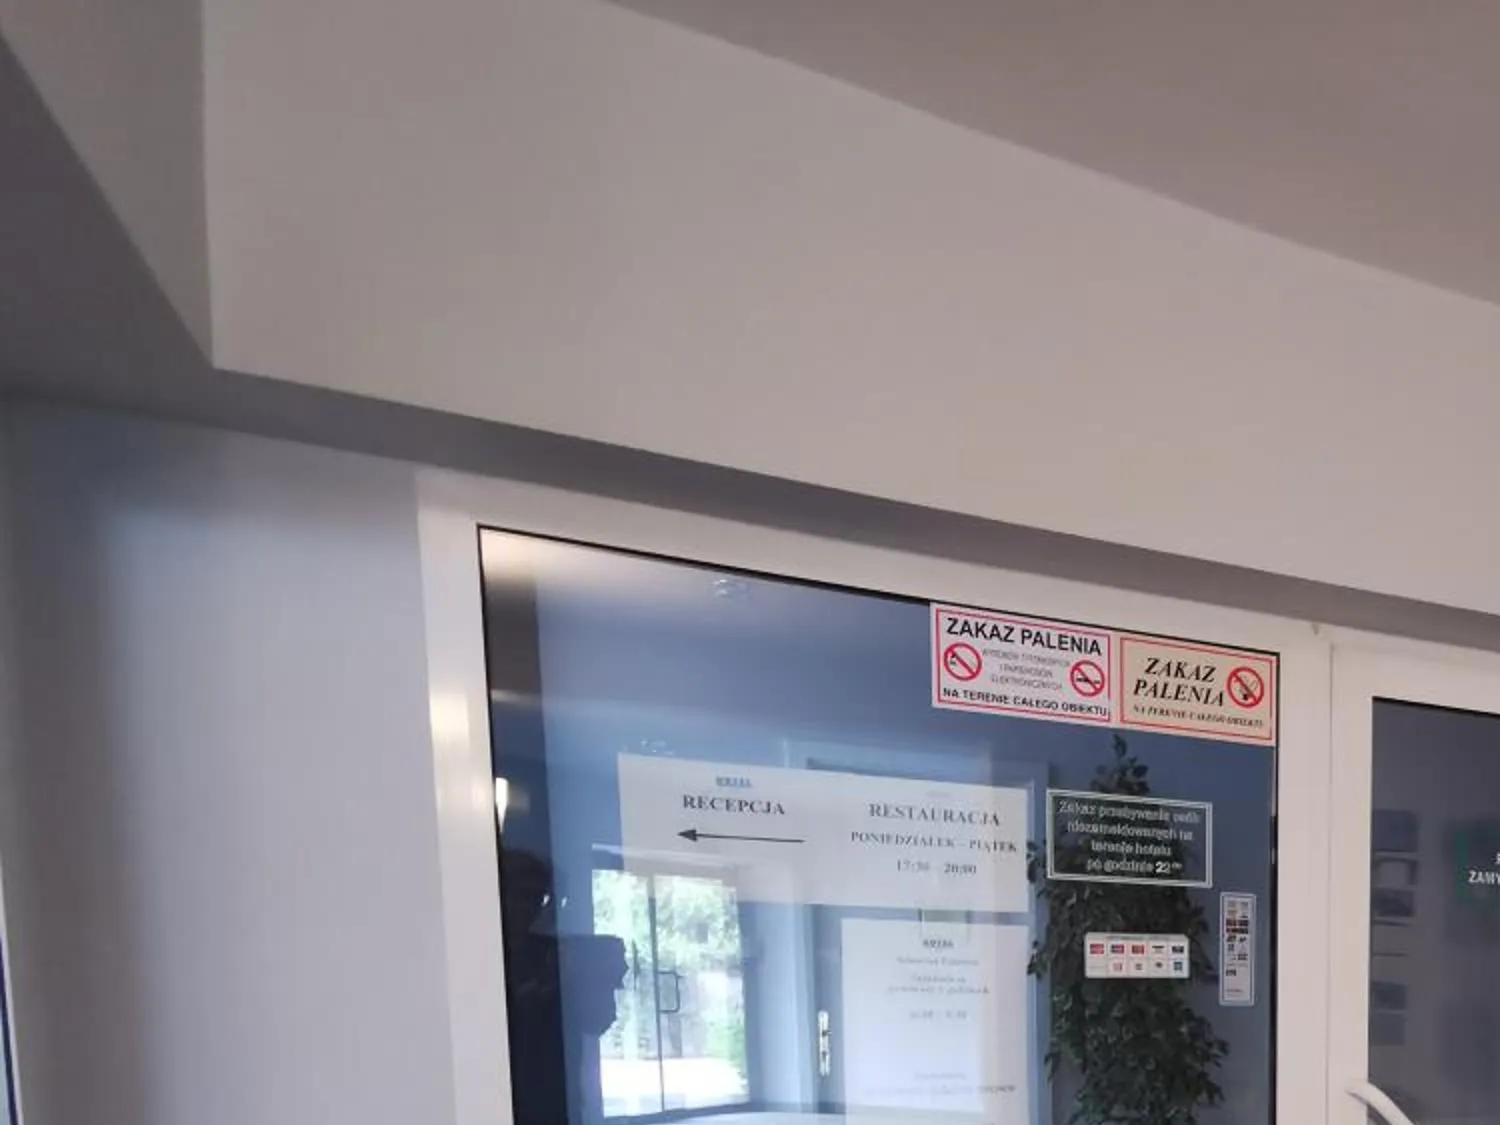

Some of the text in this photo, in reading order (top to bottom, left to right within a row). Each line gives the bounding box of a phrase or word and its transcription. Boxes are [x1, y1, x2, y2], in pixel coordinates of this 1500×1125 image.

[946, 617, 1103, 657] ZAKAZ PALENIA
[1143, 657, 1217, 684] ZAKAZ
[943, 687, 959, 699] NA
[962, 689, 1009, 705] TERENIE
[1133, 678, 1225, 708] PALENIA
[682, 793, 785, 815] RECEPCJA
[1059, 799, 1097, 815] Zakaz
[868, 803, 1001, 827] RESTAURACJA
[969, 838, 1017, 853] PIĄTEK
[1091, 839, 1172, 857] terenie hotelu
[1086, 858, 1103, 872] po
[1103, 857, 1154, 874] godzinie
